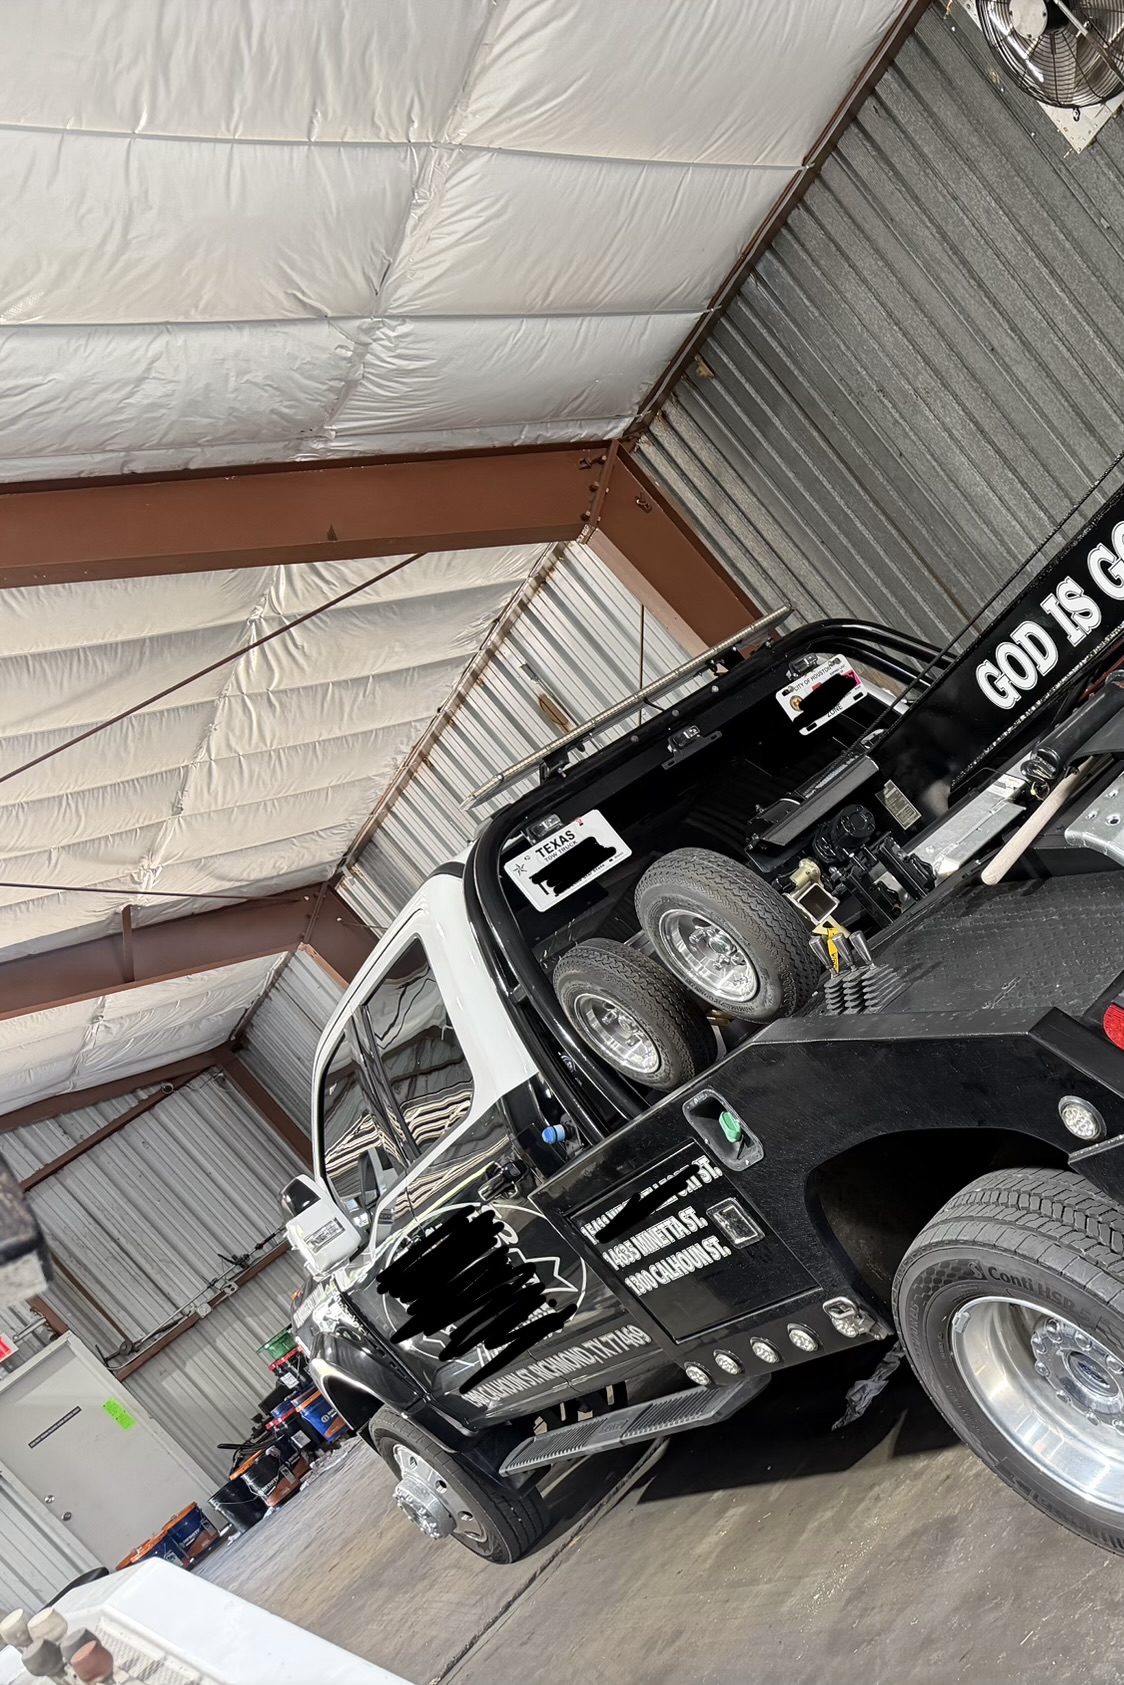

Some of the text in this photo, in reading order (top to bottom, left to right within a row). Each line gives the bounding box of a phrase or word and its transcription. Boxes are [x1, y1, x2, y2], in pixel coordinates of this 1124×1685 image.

[975, 620, 1059, 710] GOD
[1040, 575, 1102, 647] IS
[794, 682, 805, 692] CITY
[827, 704, 843, 718] ZONE
[535, 830, 576, 858] TEXAS
[544, 840, 579, 863] TOW TRUCK
[602, 1206, 709, 1271] 14635 MINETTA ST.
[625, 1235, 732, 1297] 1300 CALHOUN ST.
[987, 1266, 1034, 1292] Conti
[477, 1369, 529, 1399] CALHOUN
[582, 1336, 613, 1359] TX
[600, 1324, 652, 1354] 77469
